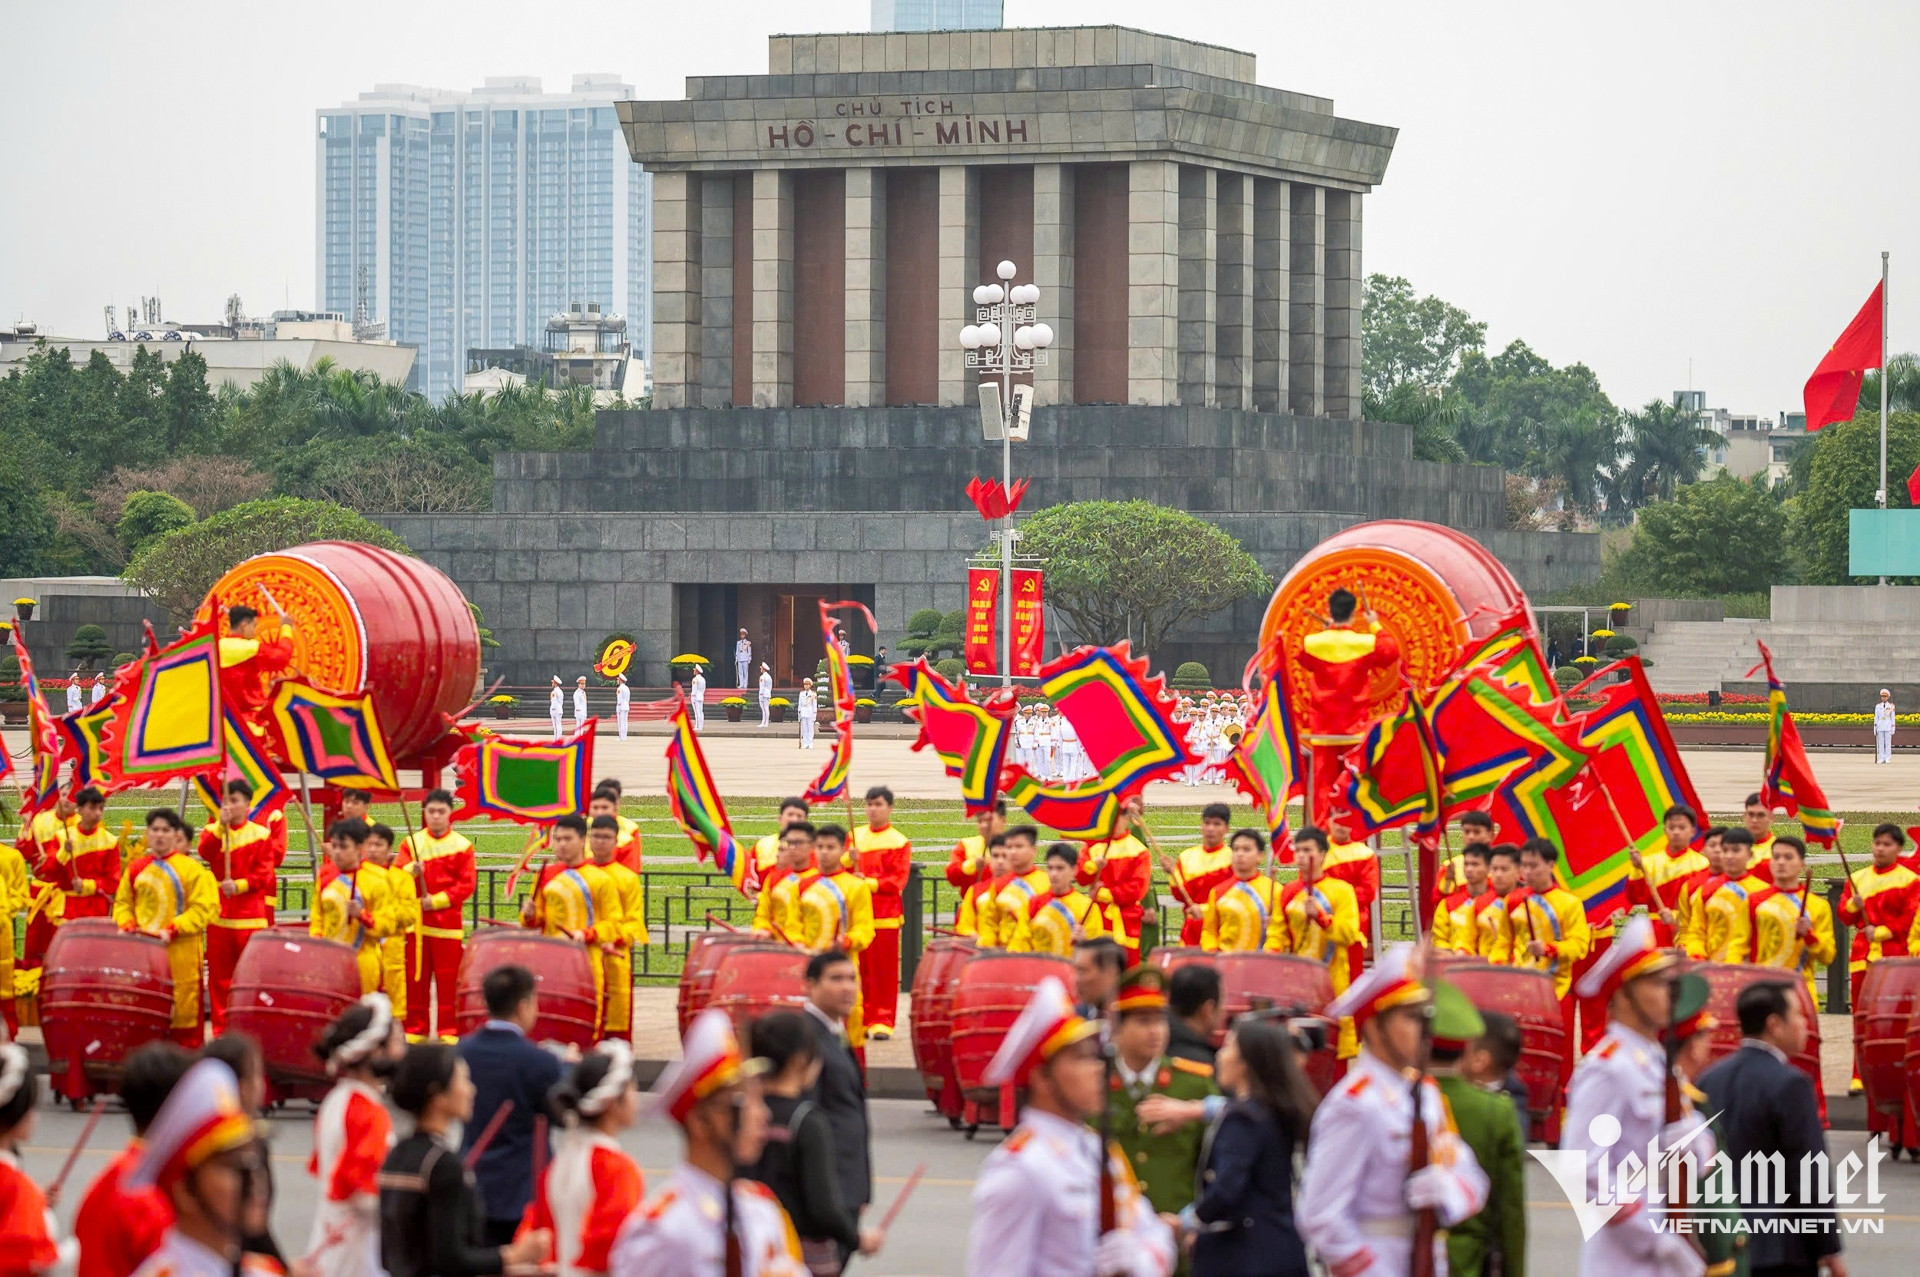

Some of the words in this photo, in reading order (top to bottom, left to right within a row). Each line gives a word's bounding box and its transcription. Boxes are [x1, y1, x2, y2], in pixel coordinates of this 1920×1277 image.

[836, 96, 882, 116] CHỦ
[900, 96, 953, 120] TỊCH
[768, 119, 815, 148] HỒ
[845, 117, 902, 146] CHÍ
